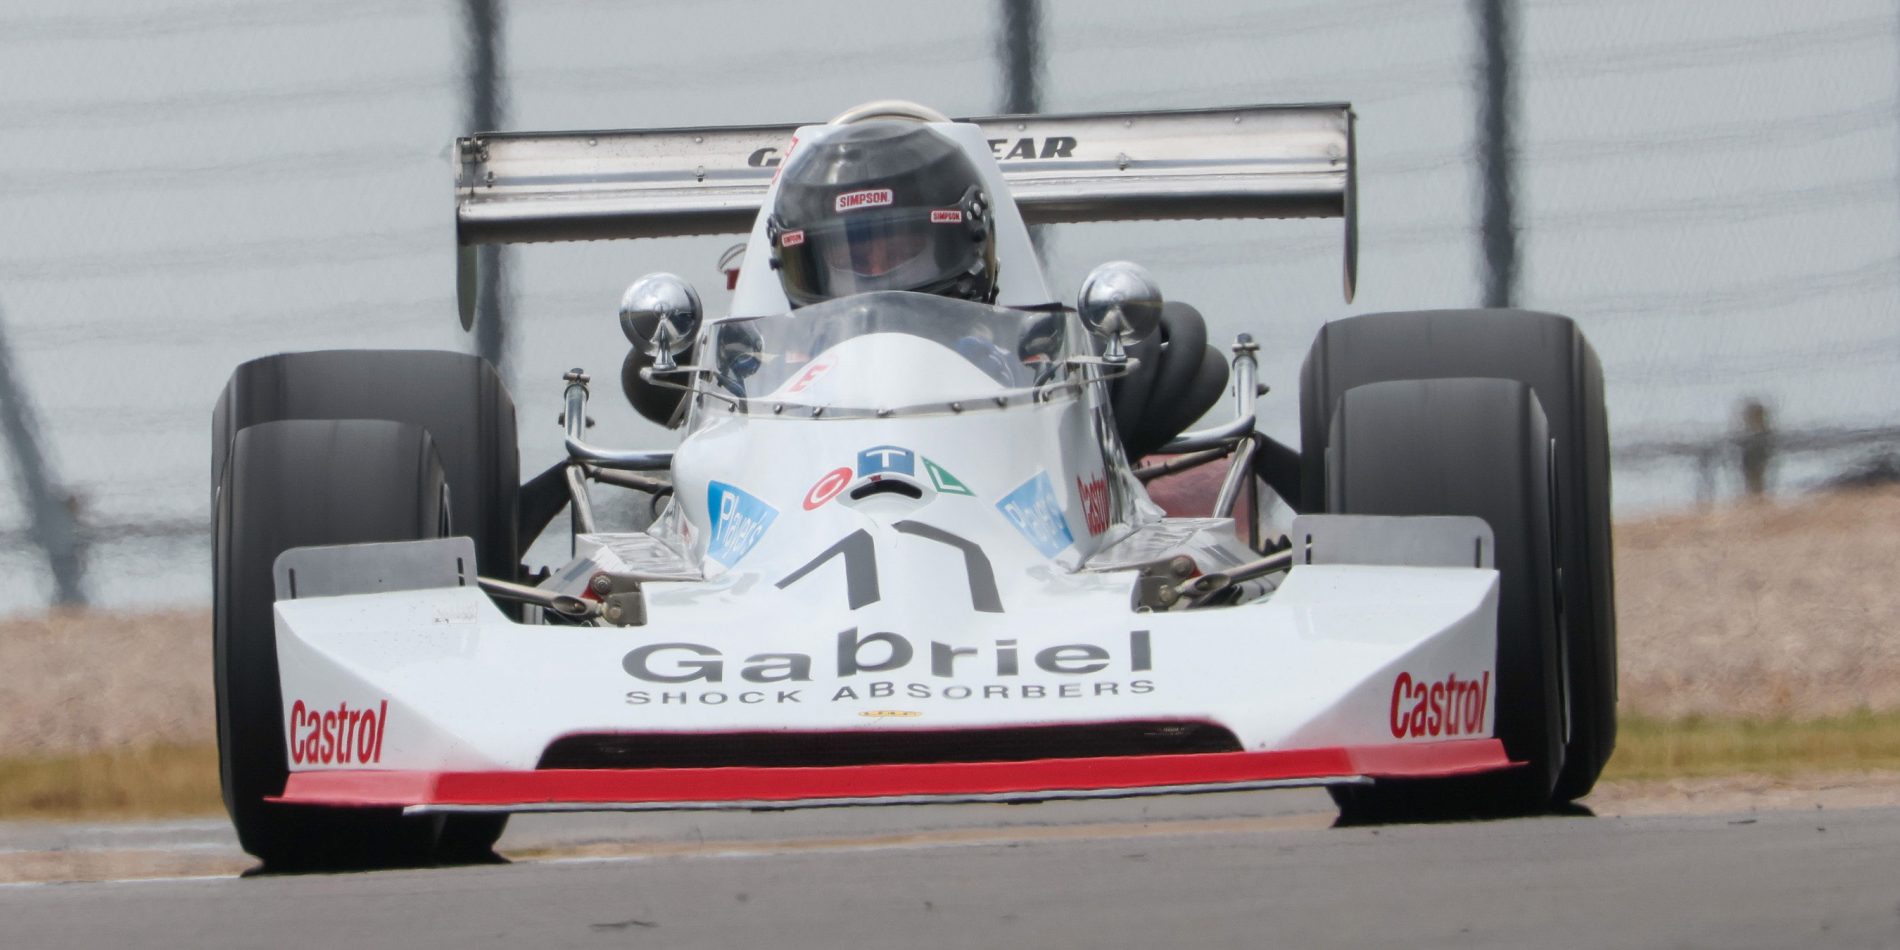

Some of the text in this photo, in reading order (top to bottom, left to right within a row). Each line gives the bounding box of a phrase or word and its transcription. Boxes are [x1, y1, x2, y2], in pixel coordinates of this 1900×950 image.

[839, 191, 888, 208] SIMPSON
[716, 490, 769, 559] Player's
[621, 626, 1153, 684] Gabriel
[625, 680, 1155, 706] SHOCK ABSORBERS
[1390, 670, 1490, 739] Castrol
[290, 699, 388, 765] Castrol
